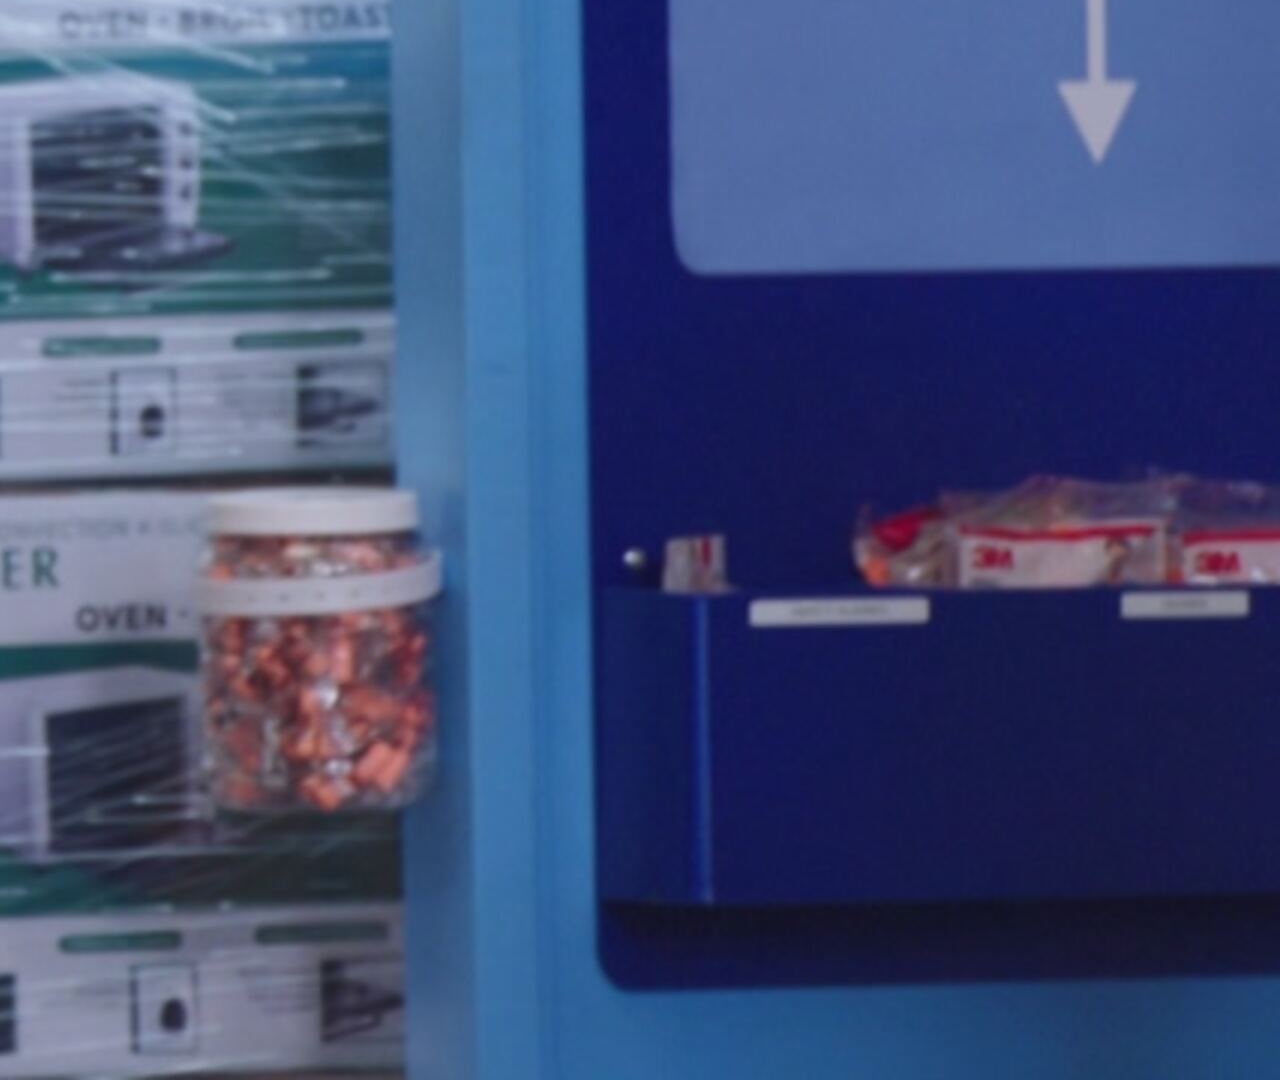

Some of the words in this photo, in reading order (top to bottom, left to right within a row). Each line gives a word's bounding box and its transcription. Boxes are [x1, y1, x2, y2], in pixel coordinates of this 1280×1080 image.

[973, 545, 1014, 571] 3M
[1196, 551, 1242, 576] 3M
[75, 605, 168, 634] OVEN
